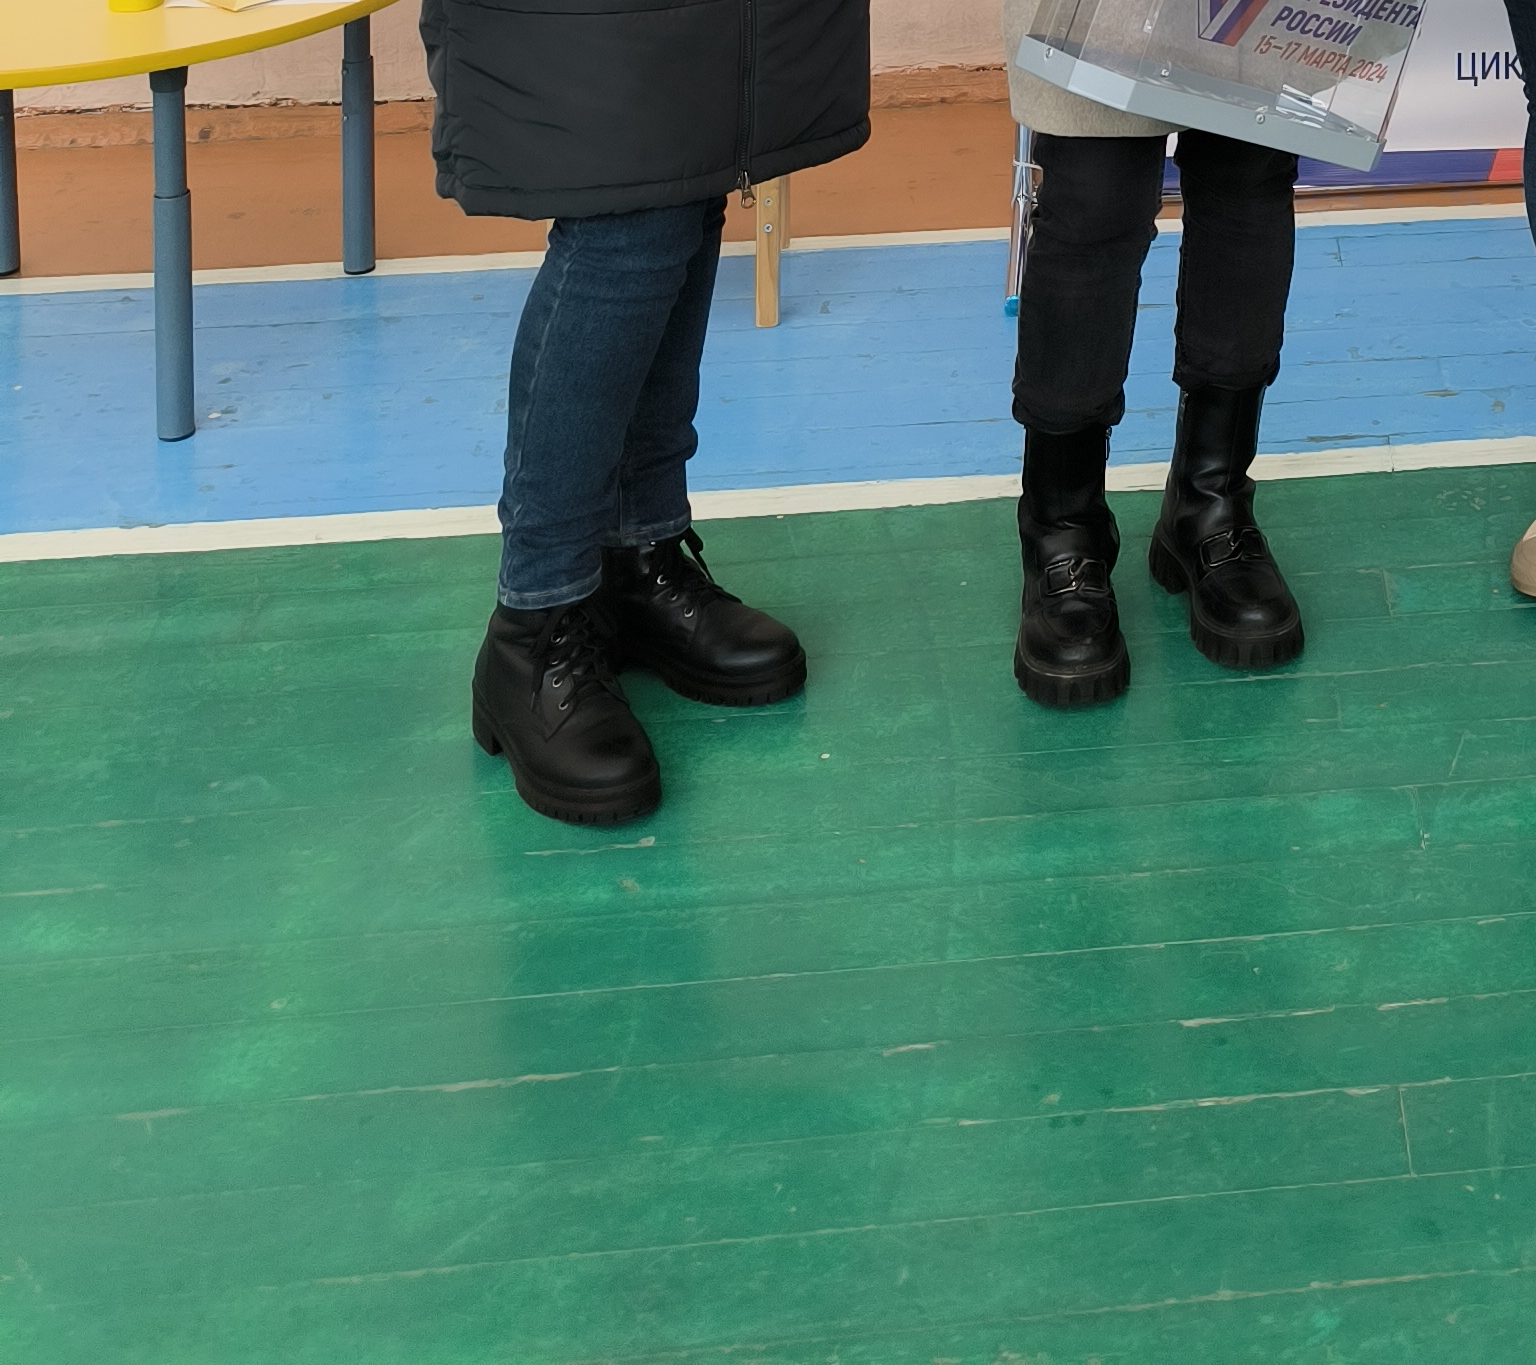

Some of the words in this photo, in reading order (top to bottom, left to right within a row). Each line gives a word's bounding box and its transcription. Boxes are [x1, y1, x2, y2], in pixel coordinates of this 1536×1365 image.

[1270, 5, 1363, 47] РОССИИ
[1297, 45, 1352, 76] МАРТА
[1348, 59, 1389, 84] 2024
